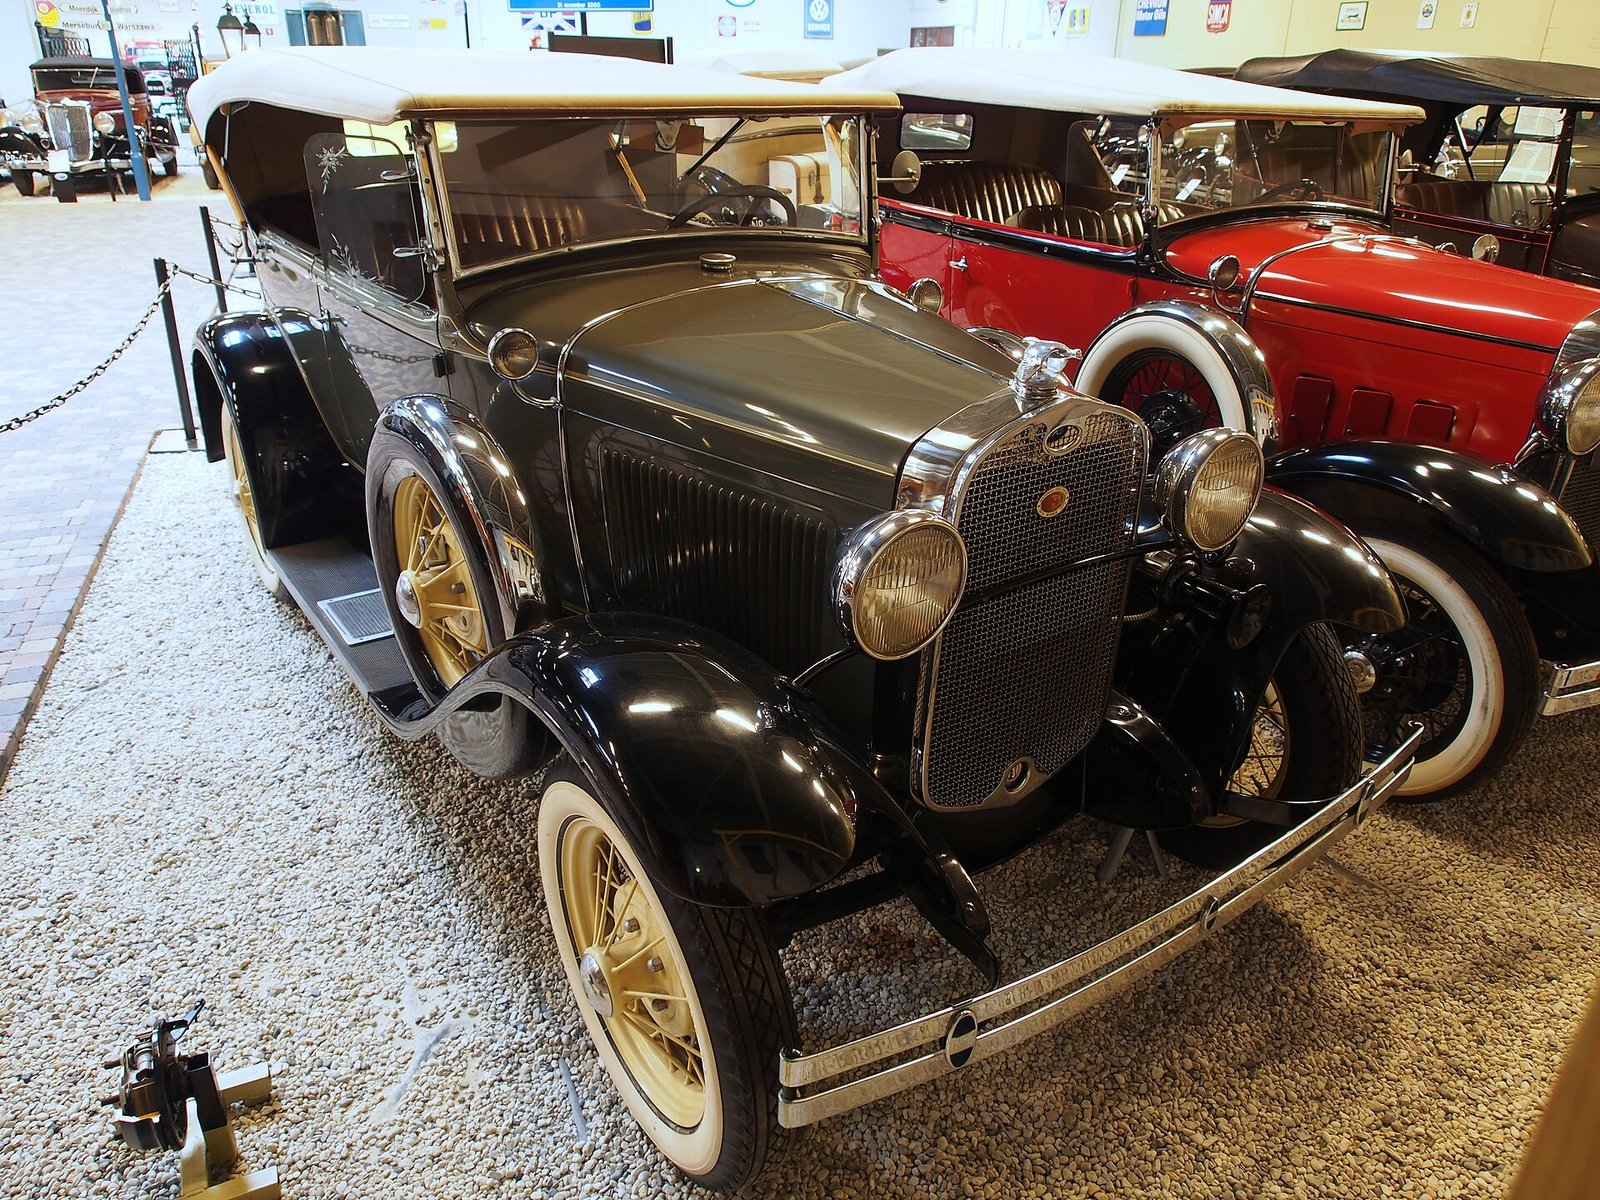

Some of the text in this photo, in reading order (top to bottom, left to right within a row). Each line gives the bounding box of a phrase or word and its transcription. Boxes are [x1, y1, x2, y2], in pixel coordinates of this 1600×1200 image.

[68, 4, 98, 14] Moerdijk
[1136, 9, 1167, 21] Motor Oils
[1207, 4, 1230, 24] SIMCA
[62, 21, 99, 29] Mersebur
[117, 23, 155, 31] Warszawa
[808, 23, 831, 32] SERVICE
